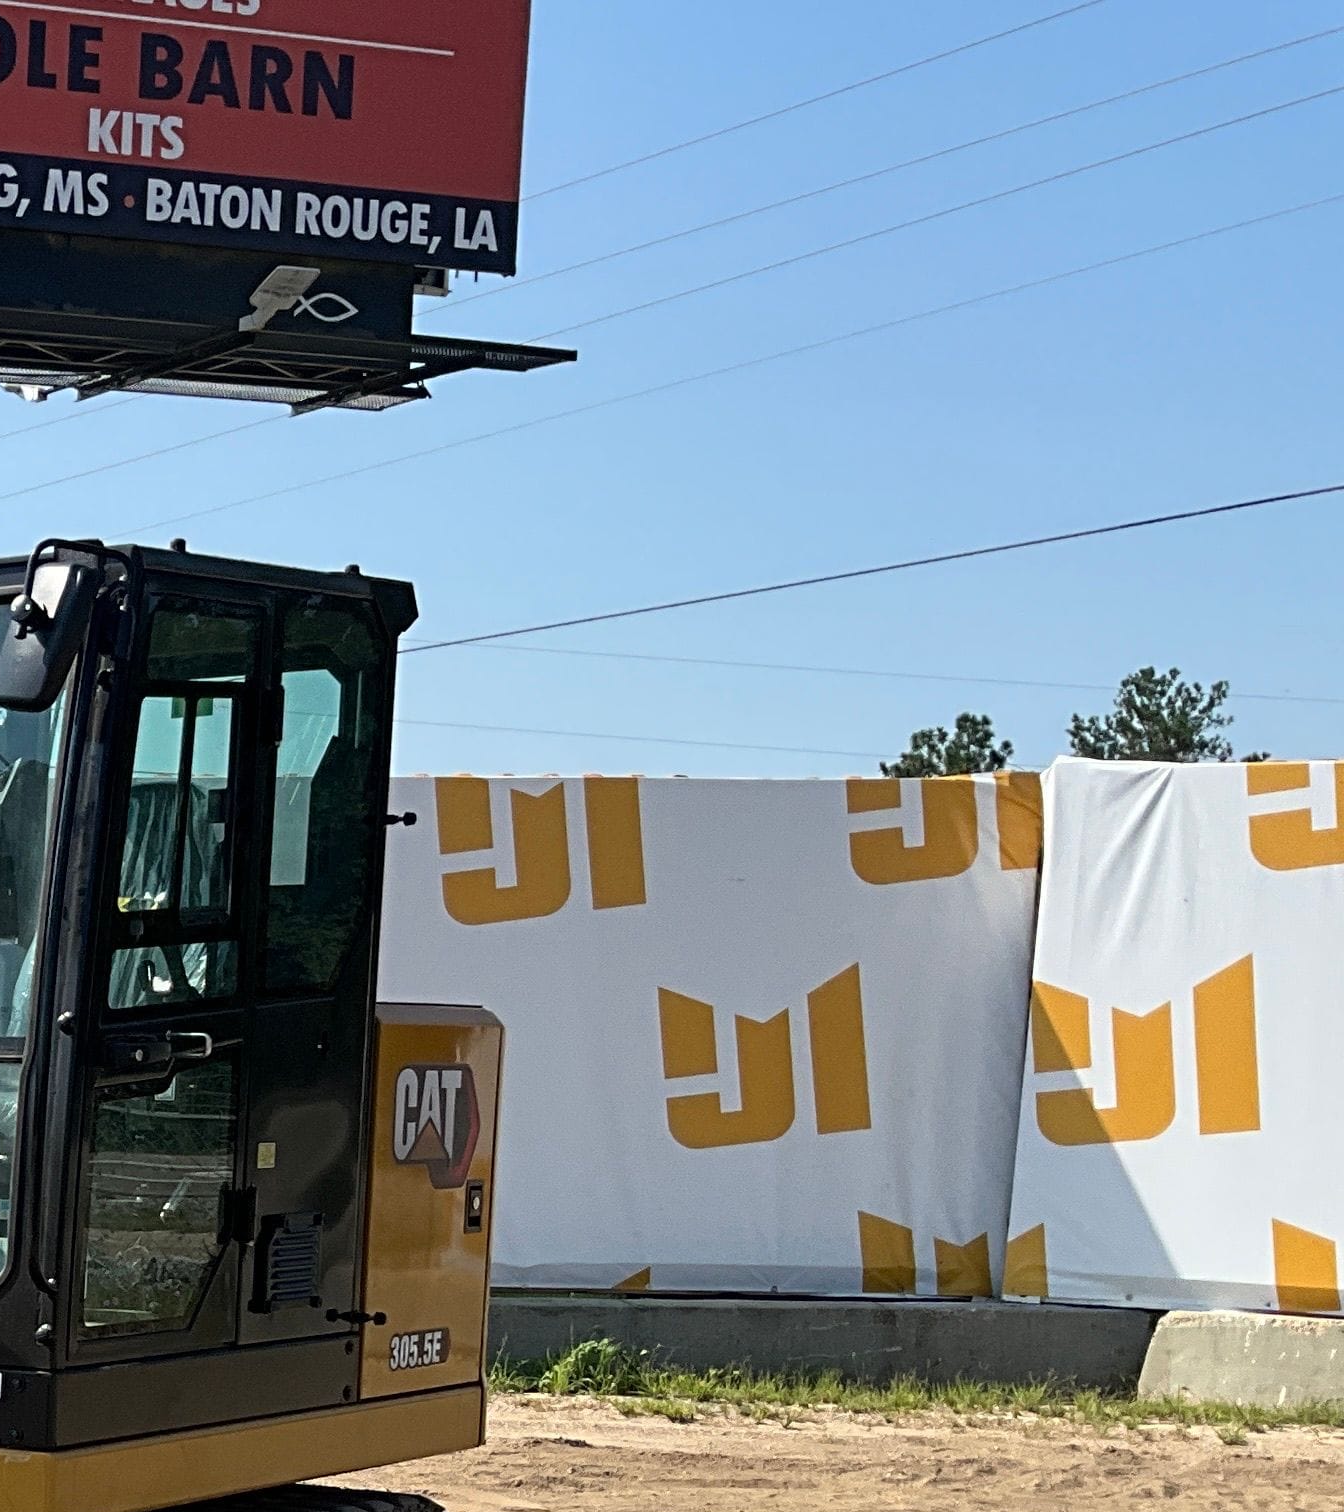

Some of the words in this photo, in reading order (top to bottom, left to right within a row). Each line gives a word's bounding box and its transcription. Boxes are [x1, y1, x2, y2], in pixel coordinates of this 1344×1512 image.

[138, 31, 356, 121] BARN
[88, 107, 185, 160] KITS
[43, 168, 109, 217] MS
[146, 178, 282, 232] BATON
[295, 192, 442, 254] ROUGE,
[454, 207, 498, 252] LA
[394, 1067, 462, 1159] CAT
[390, 1330, 442, 1370] 305.5E
